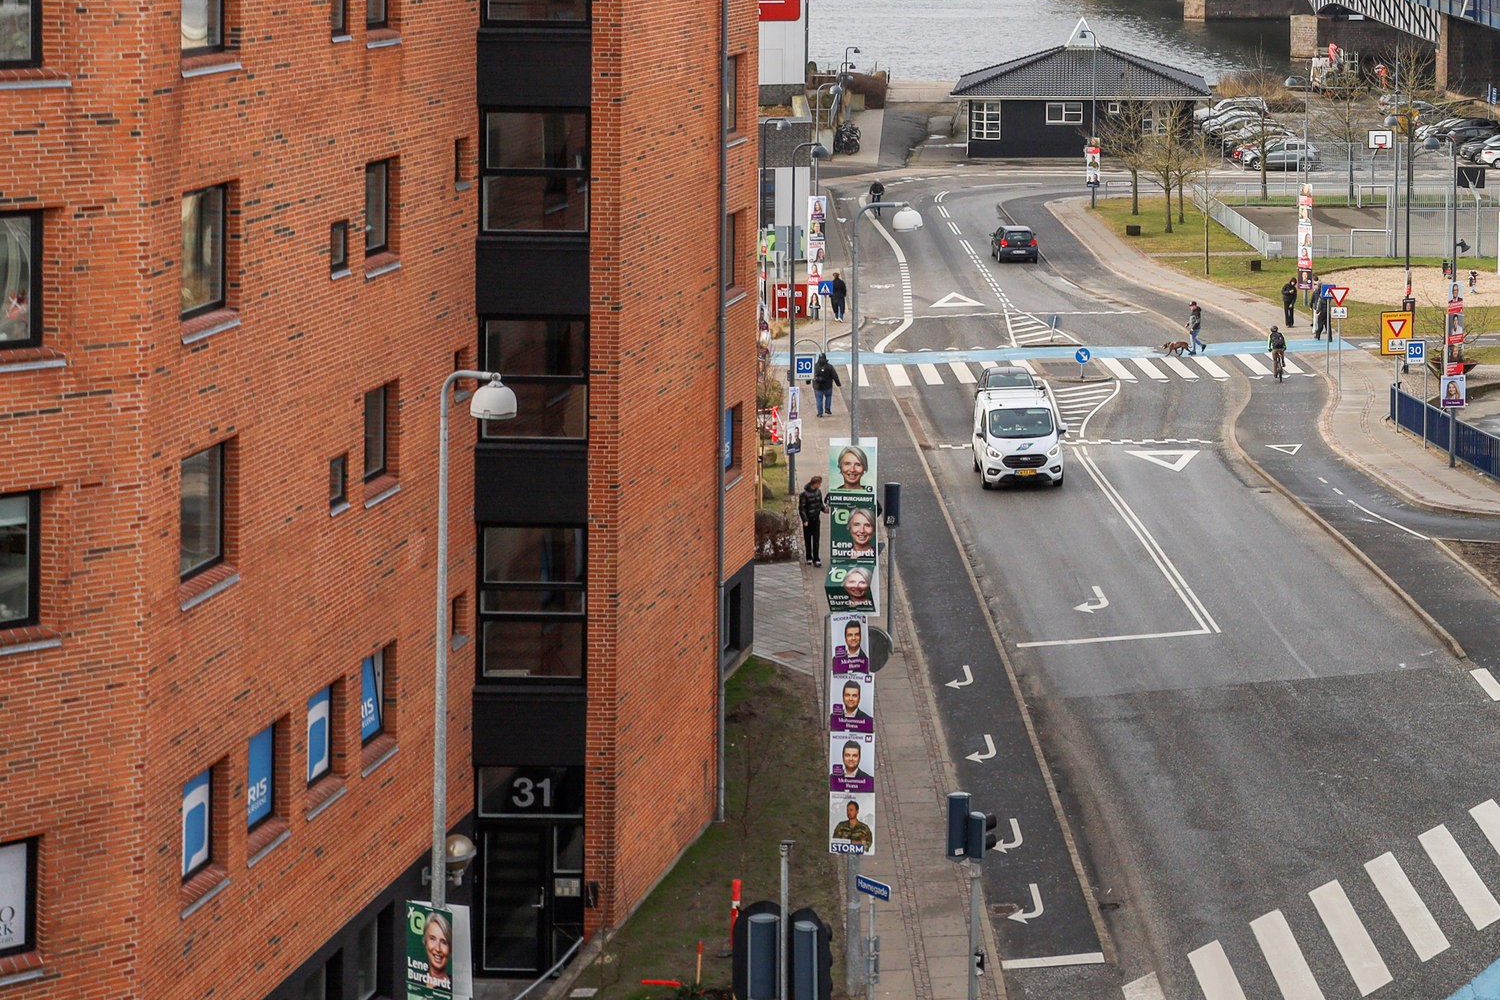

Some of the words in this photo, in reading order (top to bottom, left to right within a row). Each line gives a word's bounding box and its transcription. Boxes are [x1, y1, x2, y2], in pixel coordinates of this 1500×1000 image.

[1409, 346, 1422, 355] 30
[798, 361, 812, 370] 30
[832, 540, 852, 548] Lene
[832, 548, 874, 557] Burchardt
[512, 777, 550, 807] 31
[832, 843, 864, 853] STORM
[857, 879, 888, 897] Havnegade
[407, 956, 429, 971] Lene
[407, 967, 451, 990] Burchardt
